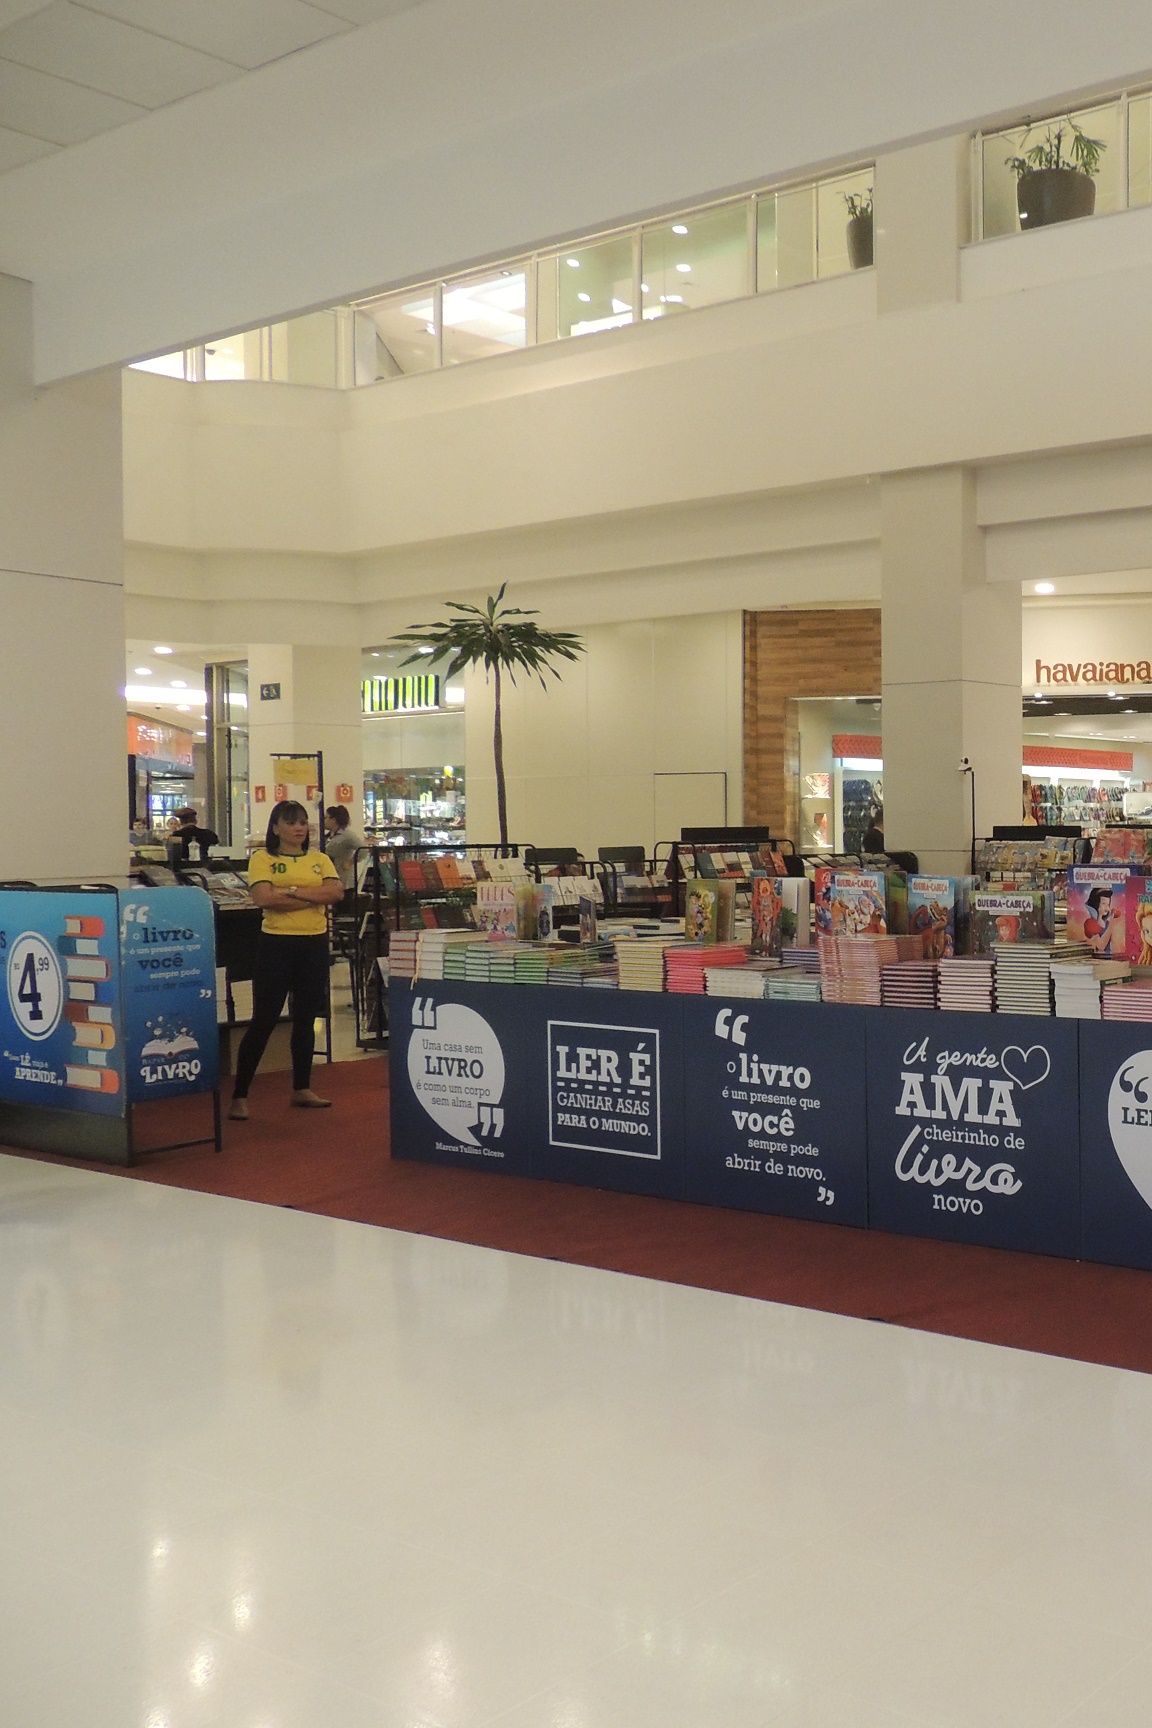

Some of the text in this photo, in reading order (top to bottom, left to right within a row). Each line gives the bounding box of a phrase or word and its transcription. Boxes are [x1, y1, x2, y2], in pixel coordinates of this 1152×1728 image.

[976, 898, 1032, 911] QUEBRA-CABEÇA
[142, 927, 194, 943] livro
[137, 953, 183, 970] você
[422, 1039, 483, 1054] Uma casa sem
[903, 1036, 999, 1075] A gente
[15, 1067, 57, 1084] APRENDE
[139, 1059, 201, 1084] LIVRO
[424, 1055, 484, 1079] LIVRO
[555, 1042, 651, 1087] LER É
[726, 1052, 811, 1090] o livro
[416, 1080, 491, 1098] é como um corpo
[722, 1086, 820, 1109] é um presente que
[895, 1071, 1022, 1127] AMA
[431, 1095, 474, 1109] sem alma.
[557, 1091, 650, 1116] GANHAR ASAS
[557, 1113, 651, 1137] PARA O MUNDO.
[732, 1108, 795, 1137] você
[748, 1137, 819, 1157] sempre pode
[923, 1124, 1025, 1150] cheirinho de
[725, 1153, 826, 1181] abrir de novo.
[894, 1124, 1023, 1195] livro
[932, 1193, 984, 1215] novo
